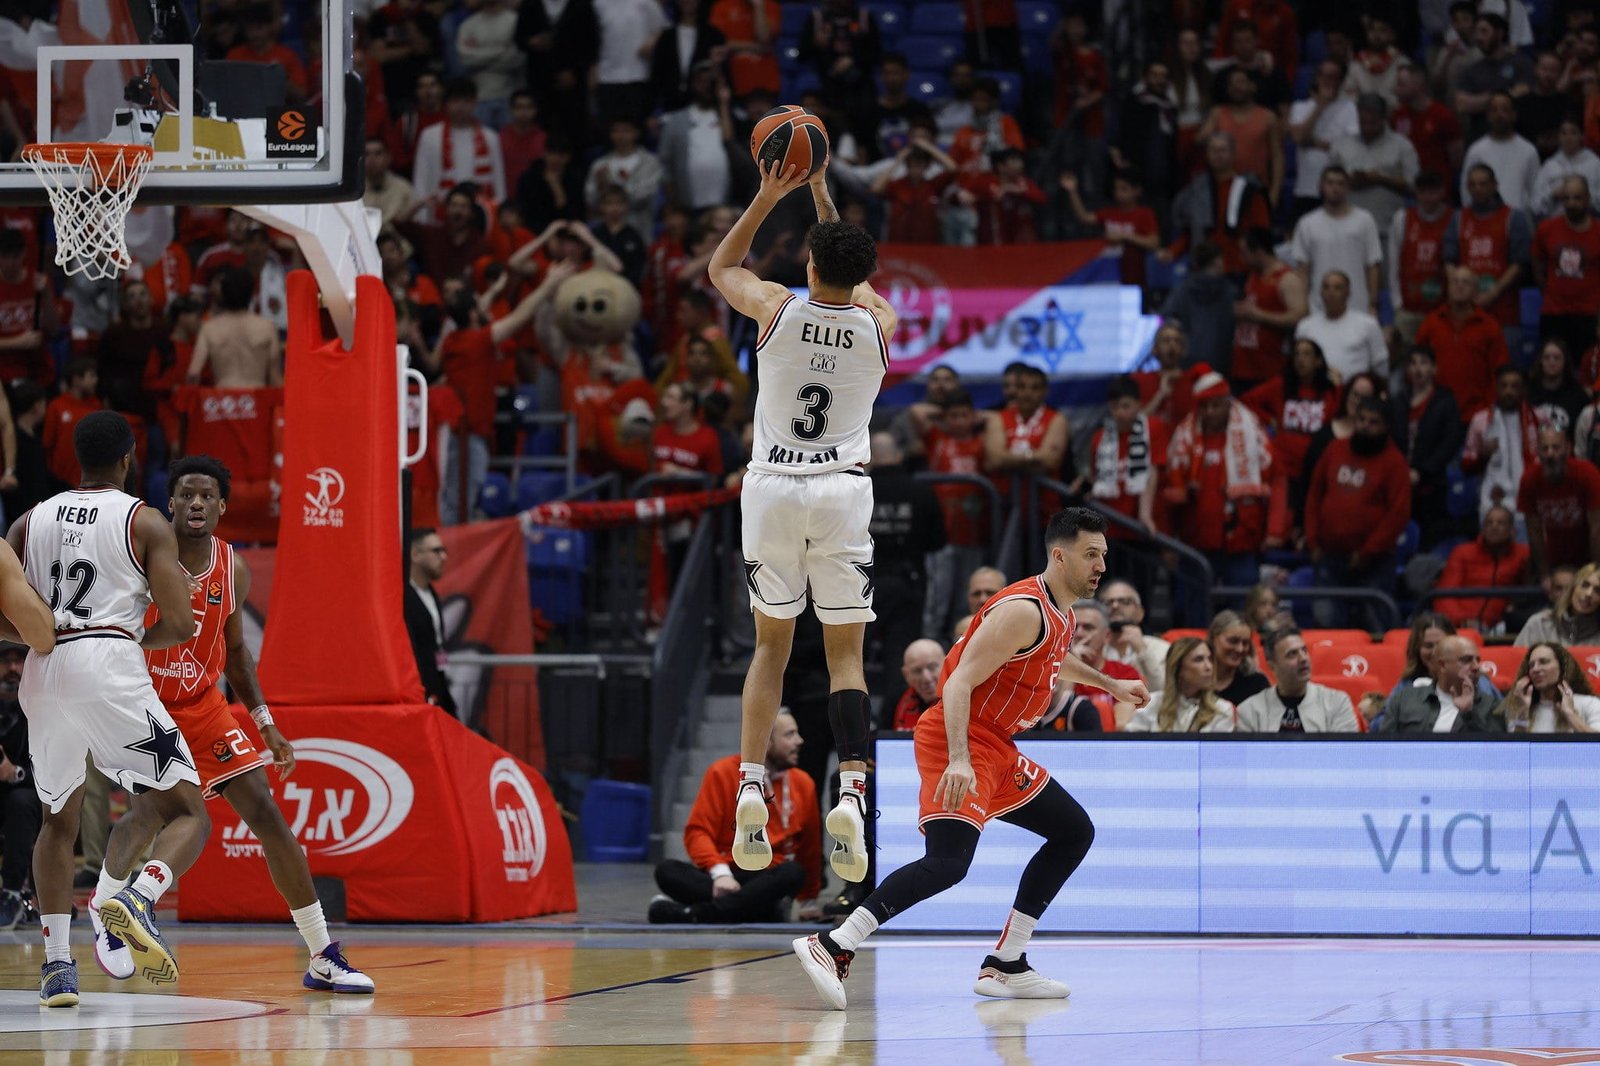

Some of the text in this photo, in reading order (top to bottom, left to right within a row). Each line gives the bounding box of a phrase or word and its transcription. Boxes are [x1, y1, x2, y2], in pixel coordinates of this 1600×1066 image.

[267, 143, 316, 153] EuroLeague
[801, 322, 854, 349] ELLIS
[791, 383, 833, 441] 3
[768, 445, 839, 464] MILAN
[56, 505, 99, 525] NEBO
[181, 661, 197, 678] IBI
[225, 729, 256, 756] 2
[1362, 796, 1593, 875] via A
